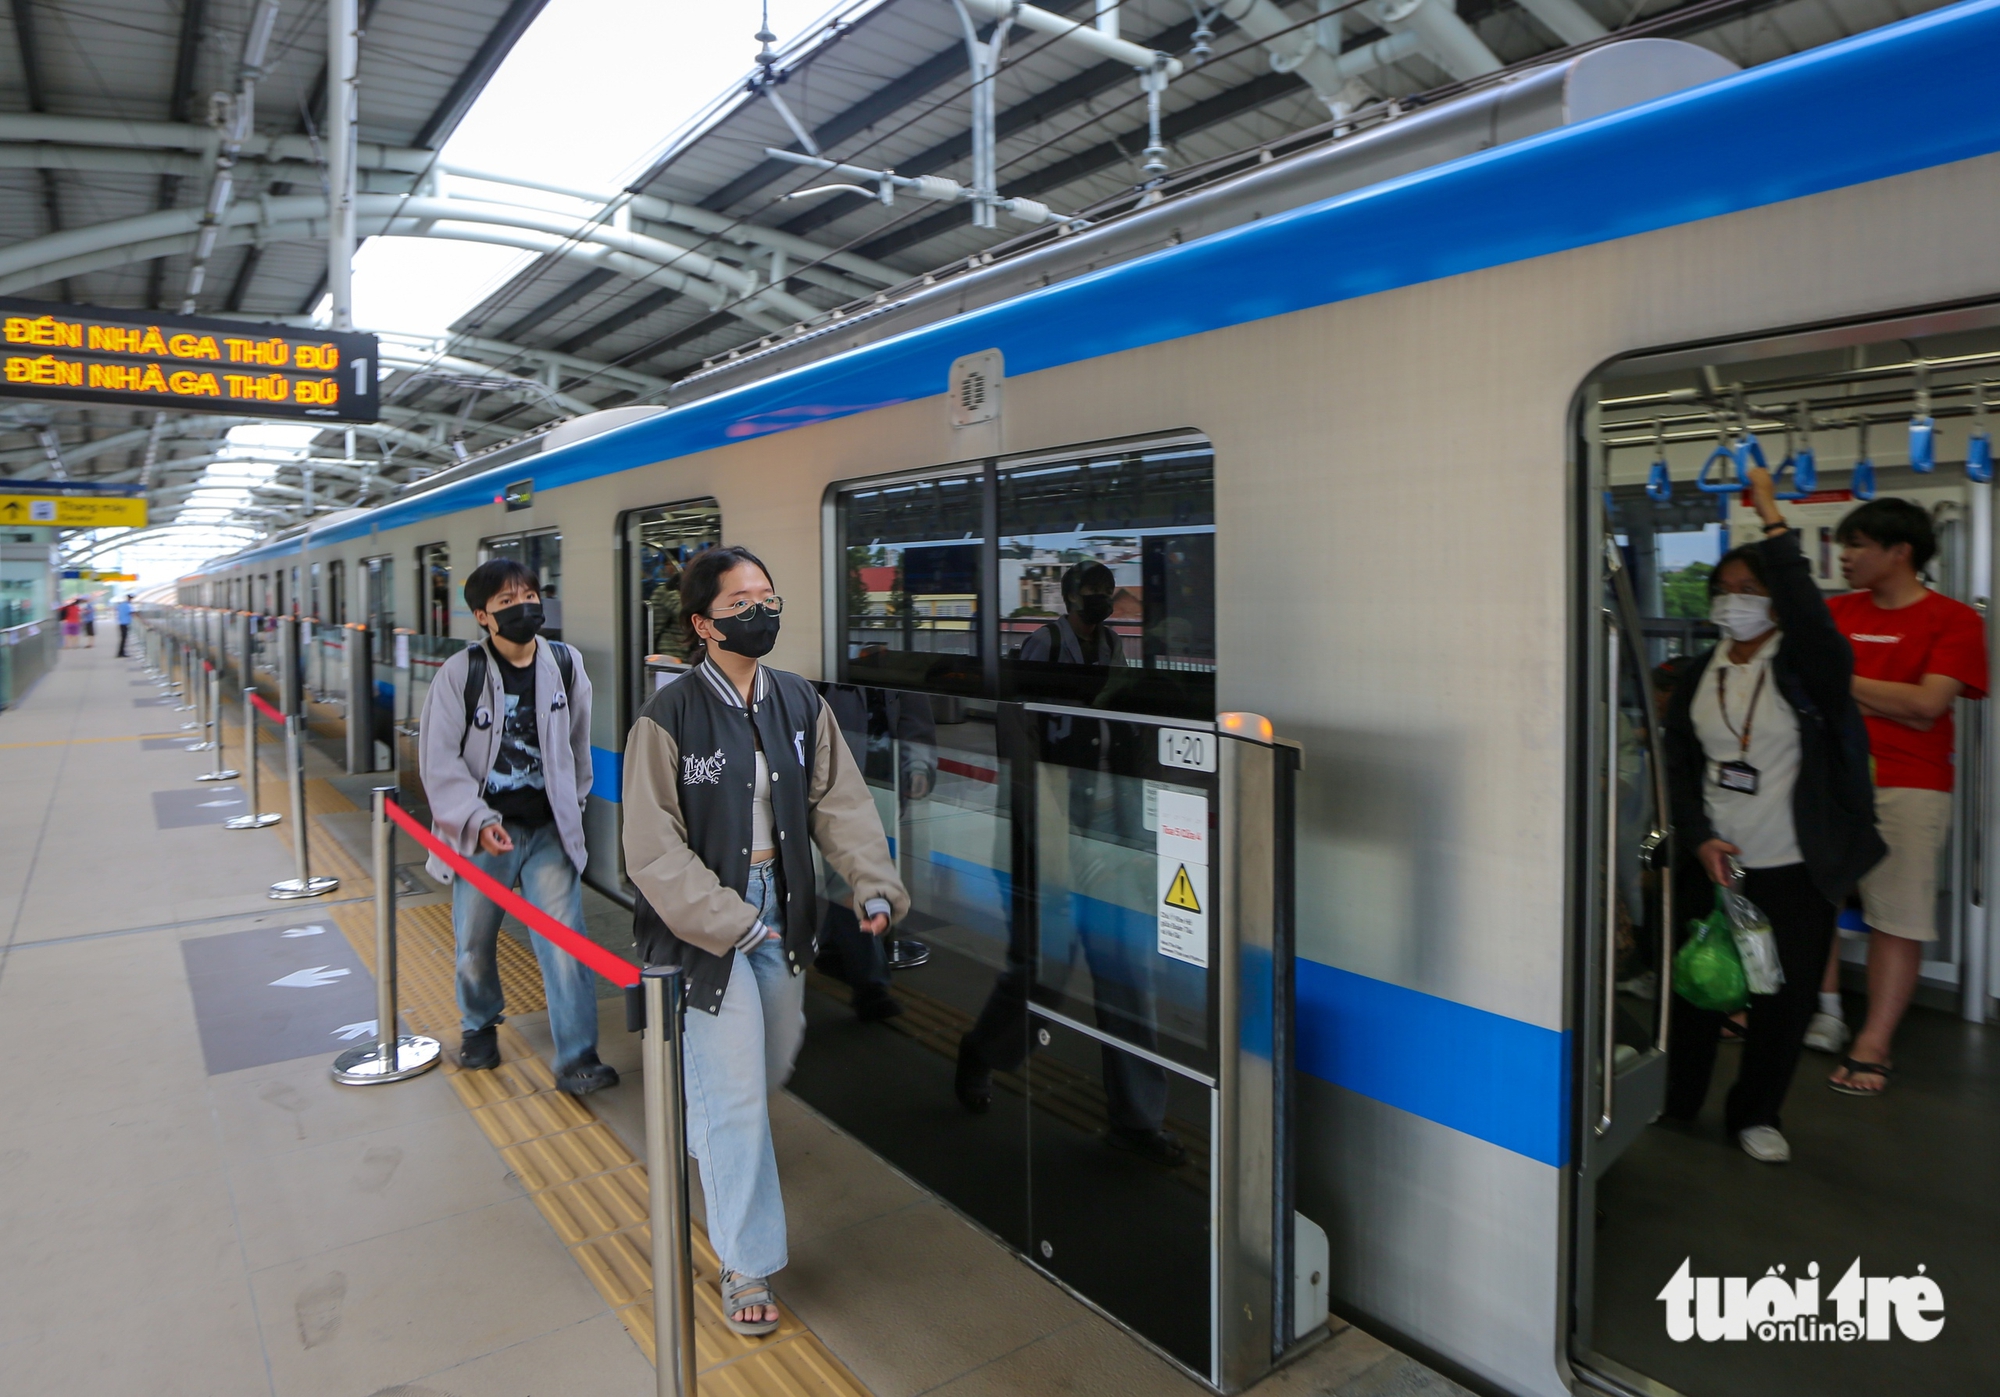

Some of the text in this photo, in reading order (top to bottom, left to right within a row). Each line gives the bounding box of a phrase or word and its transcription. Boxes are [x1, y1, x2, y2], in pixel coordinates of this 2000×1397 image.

[2, 314, 83, 347] ĐẾN
[88, 325, 169, 355] NHÀ
[168, 333, 221, 360] GA
[3, 353, 84, 386] ĐẾN
[88, 363, 170, 393] NHÀ
[168, 370, 221, 396] GA
[350, 357, 368, 396] 1
[1166, 734, 1205, 767] 1-20
